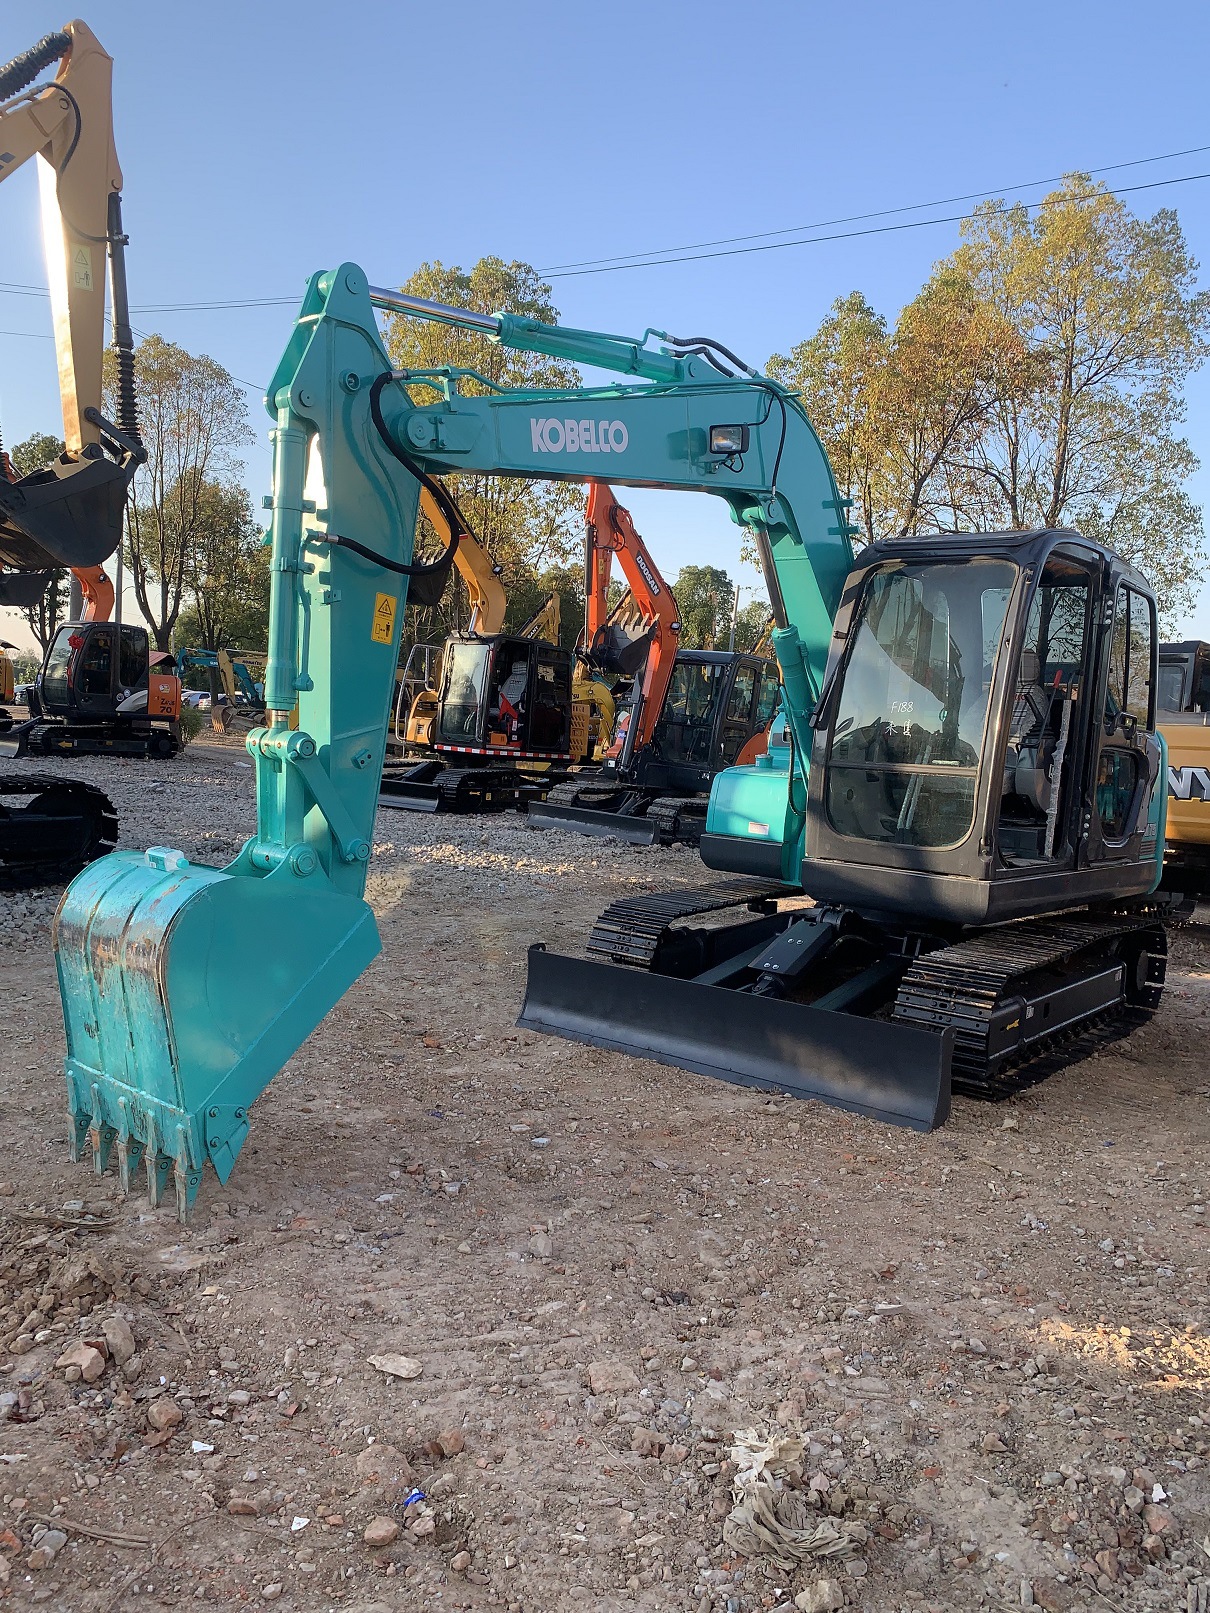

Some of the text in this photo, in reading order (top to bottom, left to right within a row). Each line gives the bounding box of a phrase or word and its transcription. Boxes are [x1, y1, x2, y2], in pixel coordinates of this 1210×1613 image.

[530, 418, 628, 453] KOBELCO
[636, 555, 660, 596] DOOSAN
[891, 701, 914, 713] F188
